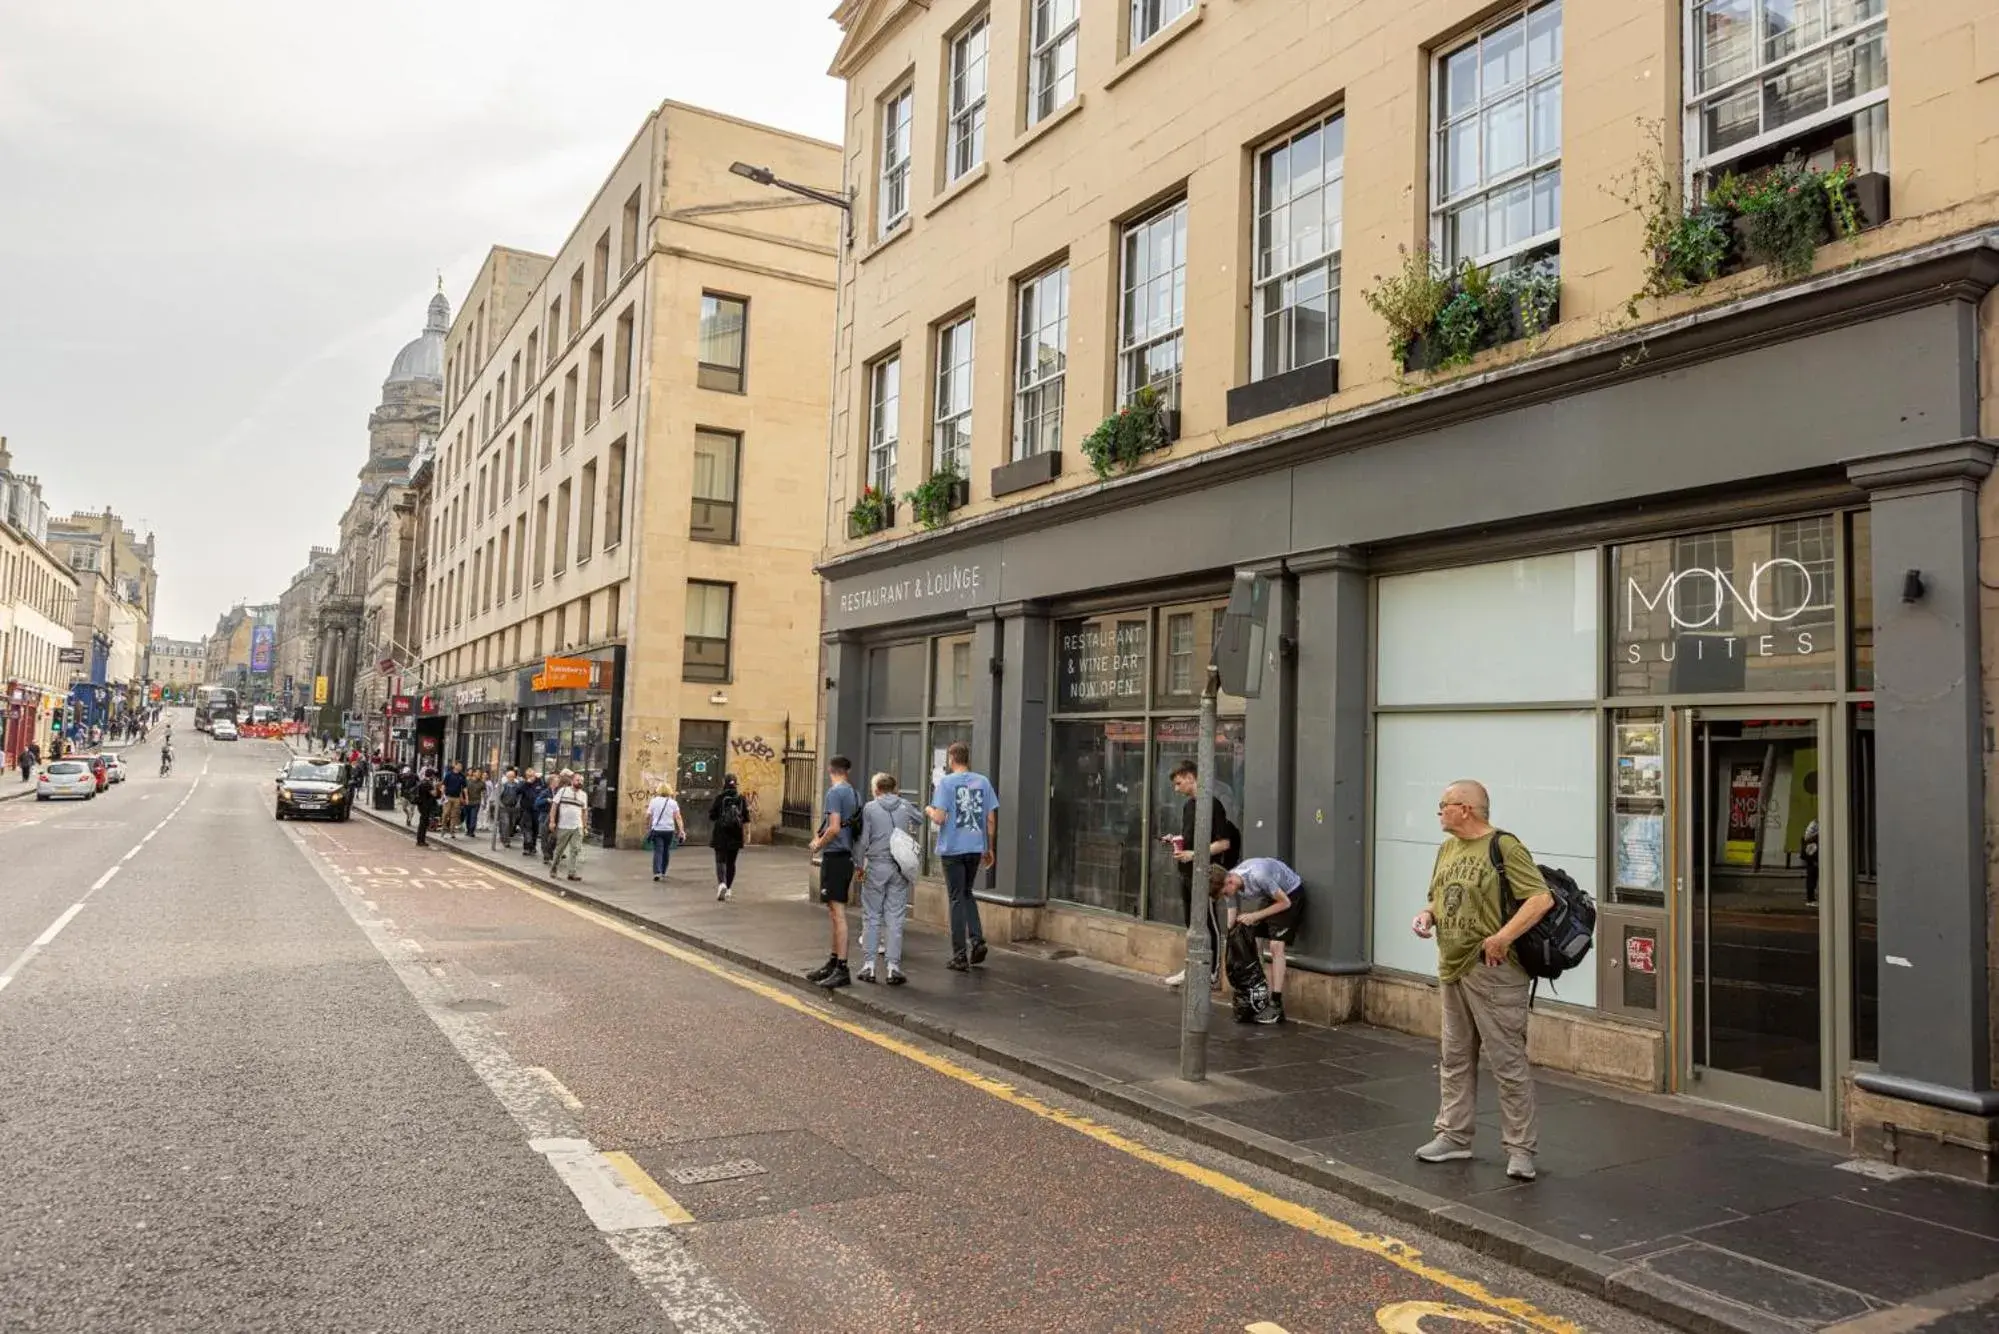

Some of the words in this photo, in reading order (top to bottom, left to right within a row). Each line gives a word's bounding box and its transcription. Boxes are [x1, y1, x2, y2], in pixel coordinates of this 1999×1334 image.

[841, 581, 911, 612] RESTAURANT
[914, 578, 922, 598] &
[926, 566, 980, 596] LOUNGE
[1628, 558, 1812, 633] MONO
[1064, 627, 1142, 650] RESTAURANT
[1628, 632, 1813, 664] SUITES
[1067, 658, 1075, 675] &
[1078, 655, 1108, 673] WINE
[1112, 653, 1139, 671] BAR
[1069, 680, 1097, 699] NOW
[1099, 679, 1135, 697] OPEN
